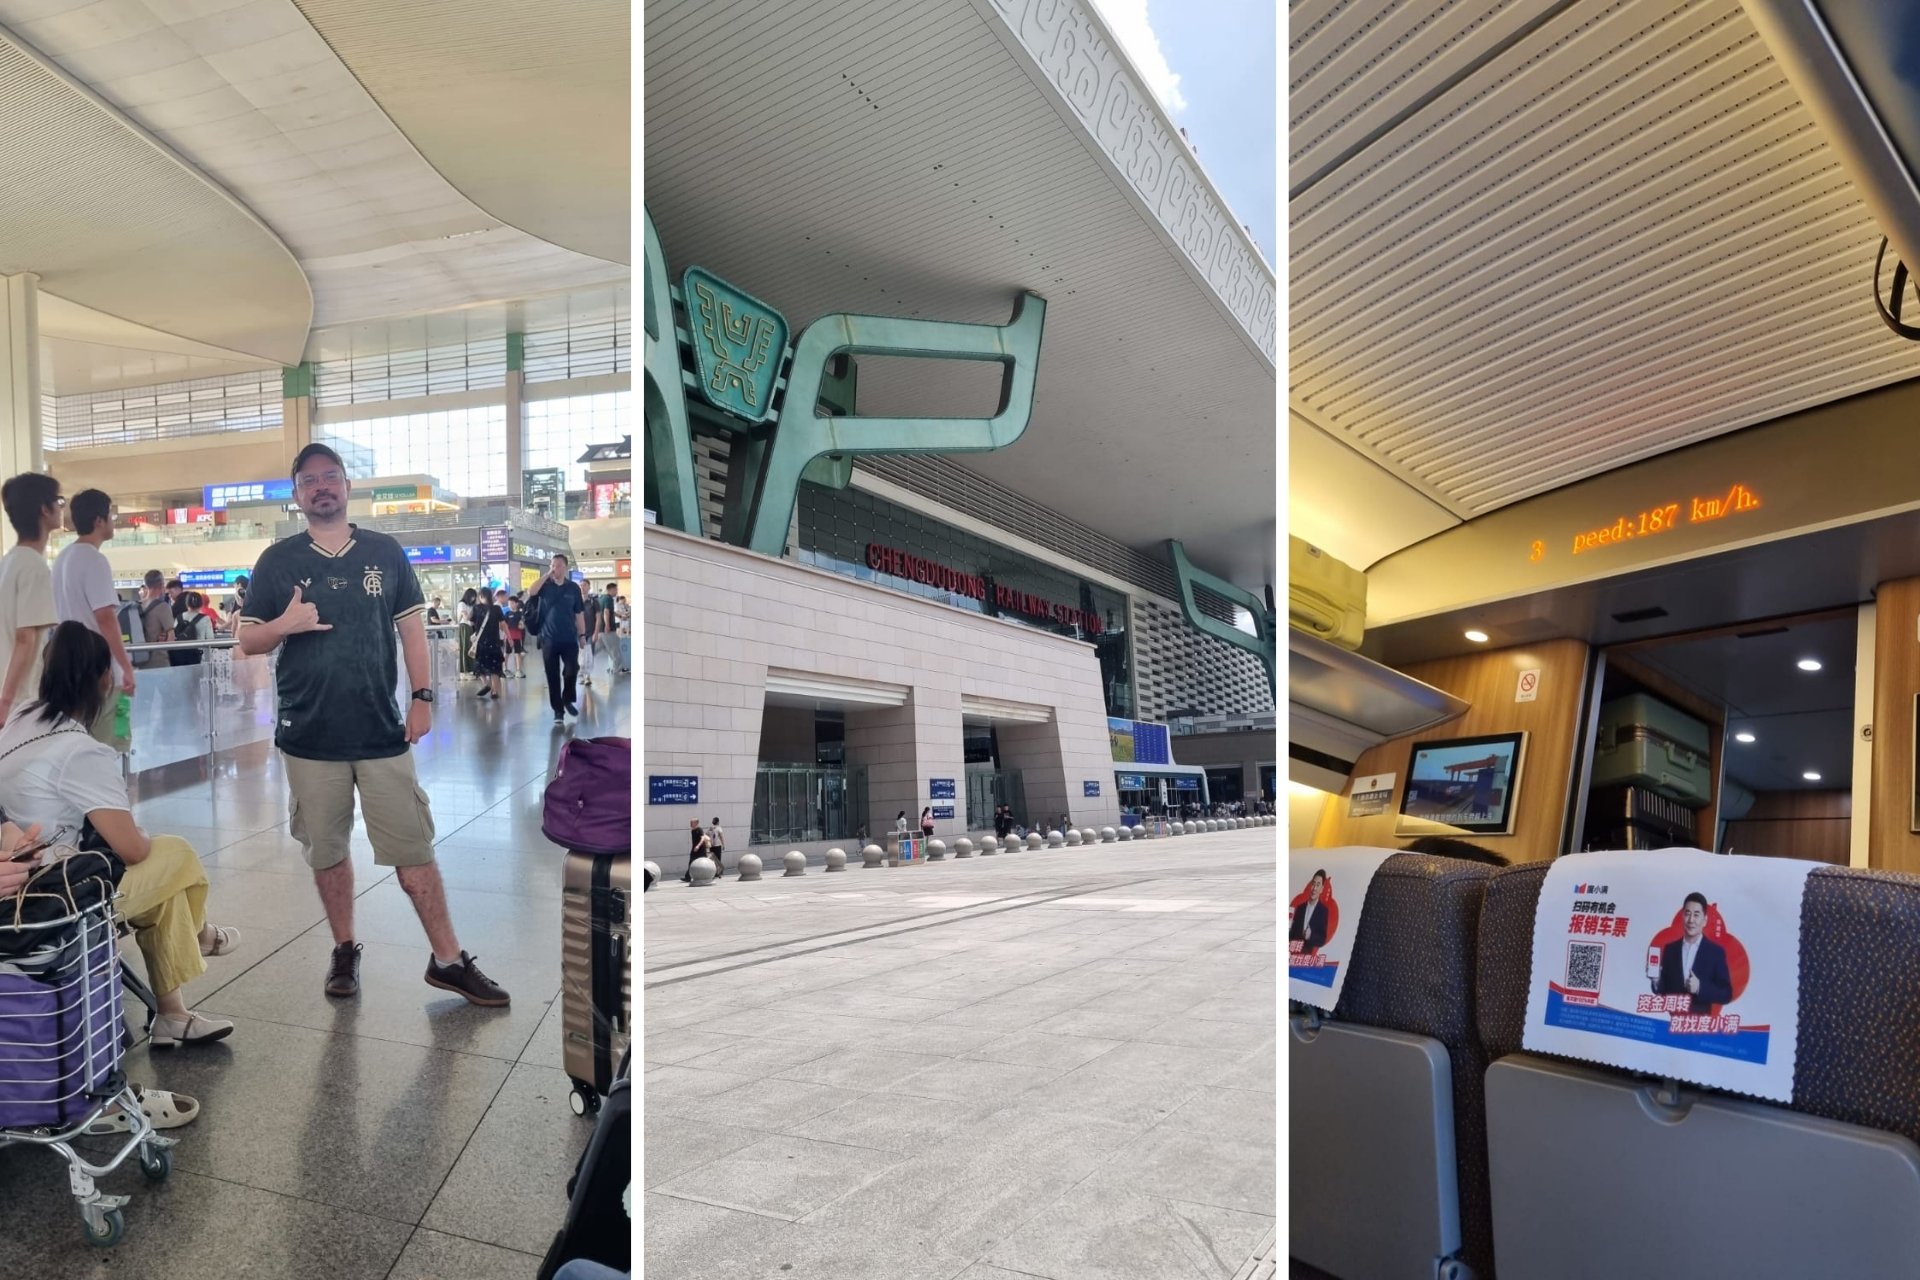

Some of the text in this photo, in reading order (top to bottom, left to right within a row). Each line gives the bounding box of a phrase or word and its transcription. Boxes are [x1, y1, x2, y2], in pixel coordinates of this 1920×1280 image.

[197, 513, 213, 522] KFC
[1530, 484, 1760, 561] 3 peed:187 km/h.
[455, 547, 472, 558] B24
[867, 543, 1104, 634] CHENGDUDONG RAILWAY STATION
[1572, 900, 1617, 914] 扫码有机会
[1568, 914, 1630, 938] 报销车票
[1637, 994, 1692, 1013] 资金周转
[1669, 1015, 1741, 1034] 就找度小满
